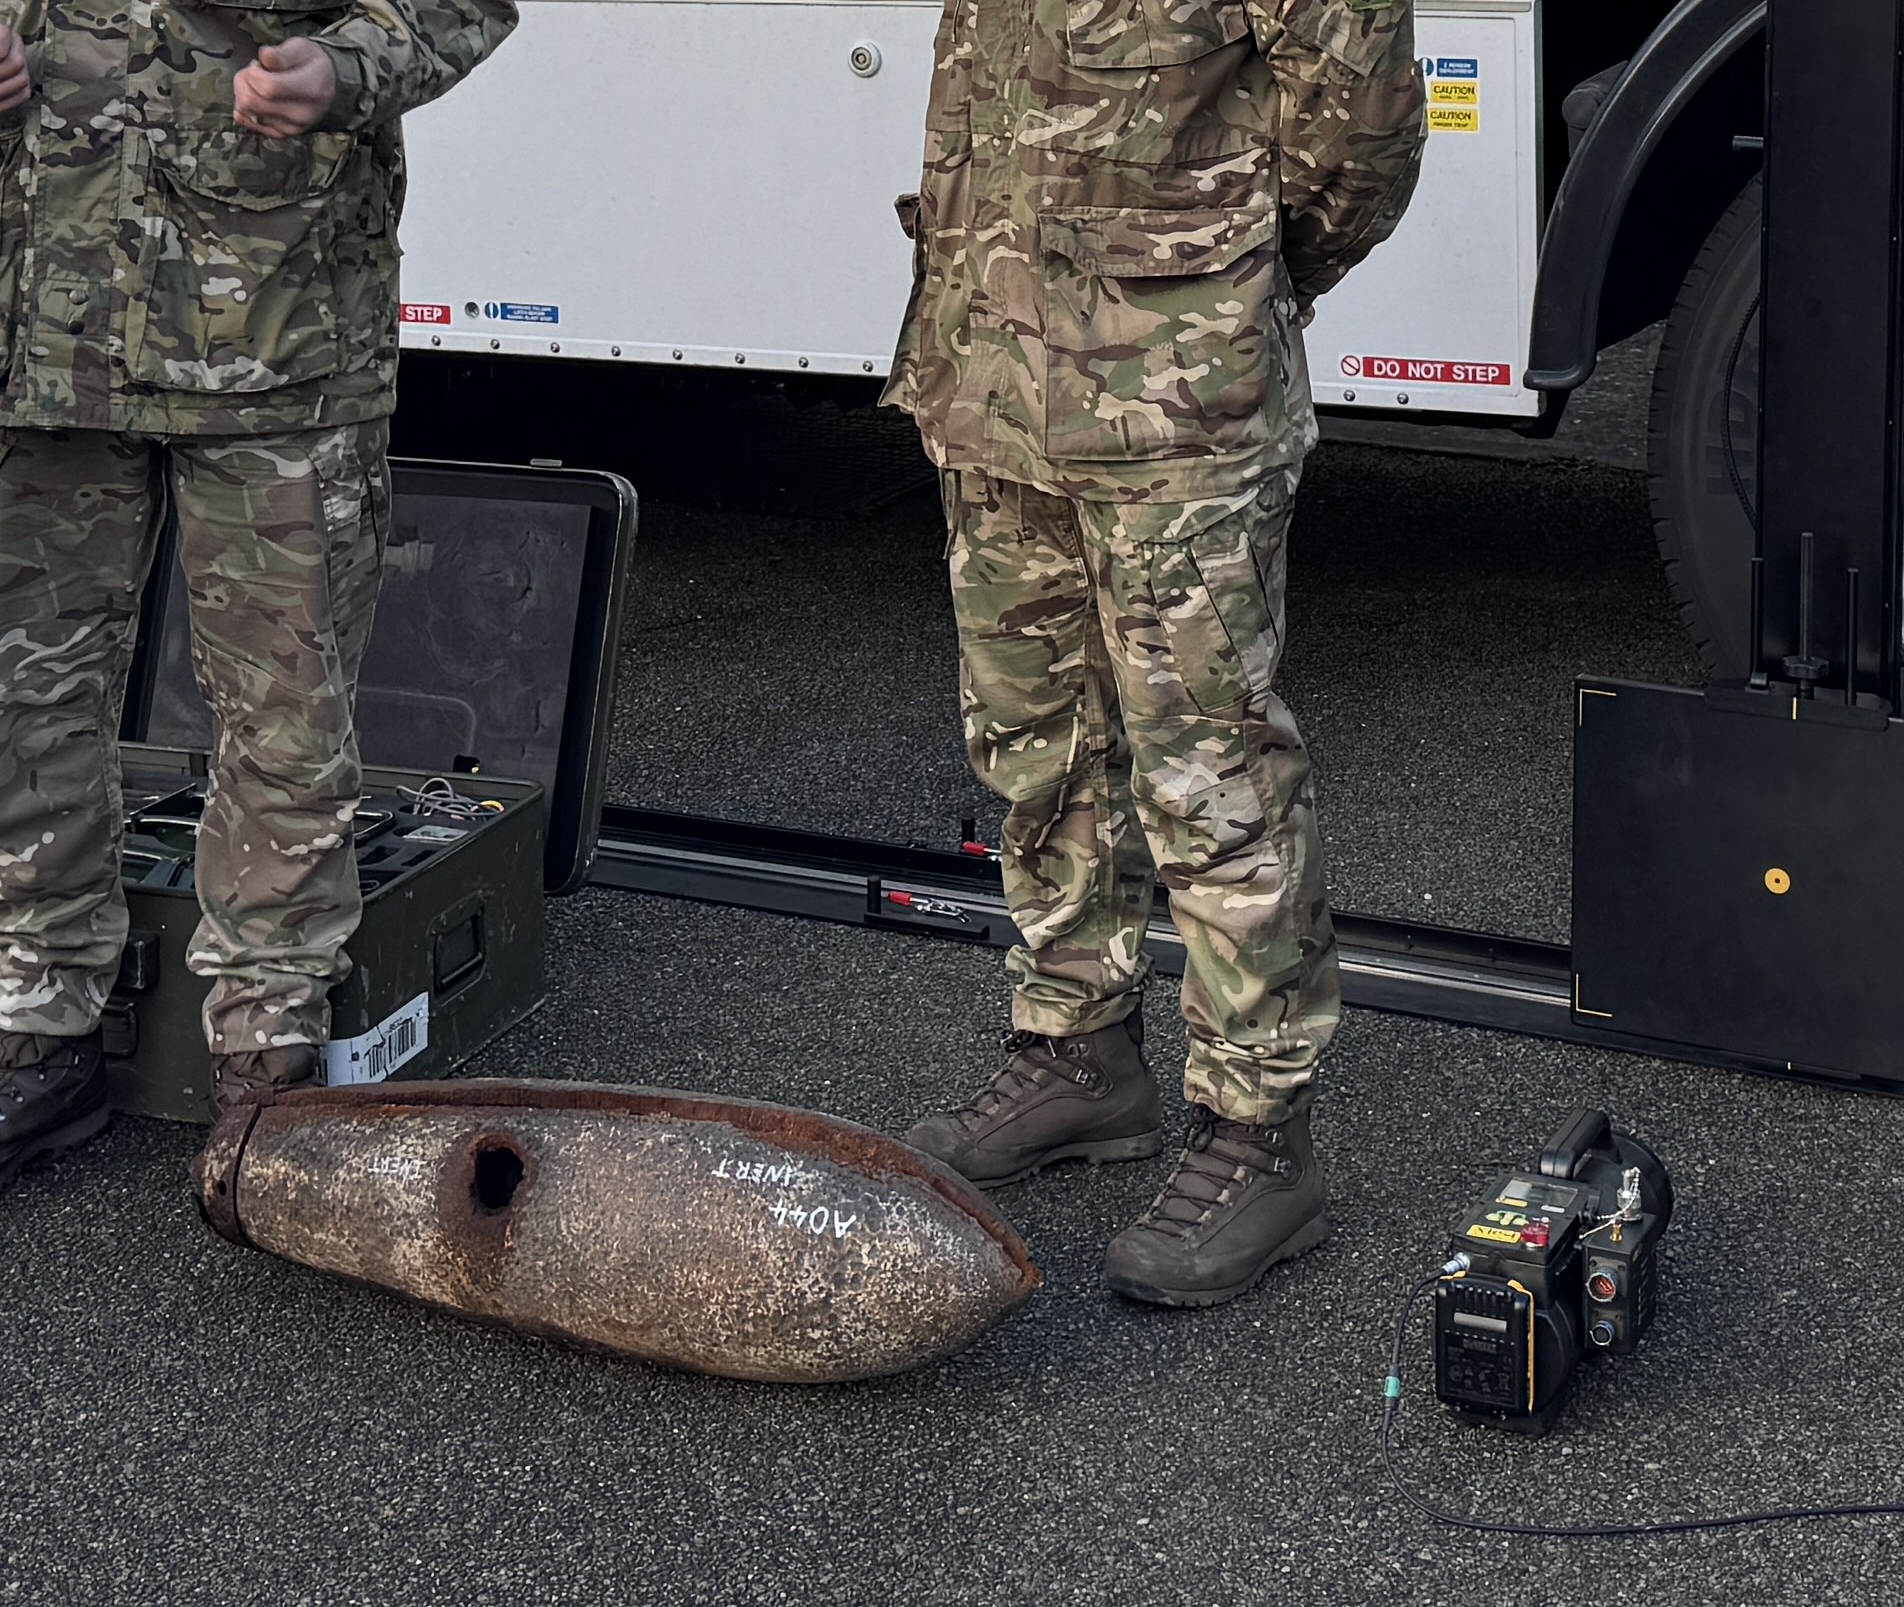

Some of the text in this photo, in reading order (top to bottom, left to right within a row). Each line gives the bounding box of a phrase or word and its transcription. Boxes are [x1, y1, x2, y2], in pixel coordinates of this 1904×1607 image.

[1433, 85, 1475, 95] CAUTION
[1429, 110, 1472, 121] CAUTION
[405, 305, 443, 321] STEP
[1373, 360, 1500, 382] DO NOT STEP
